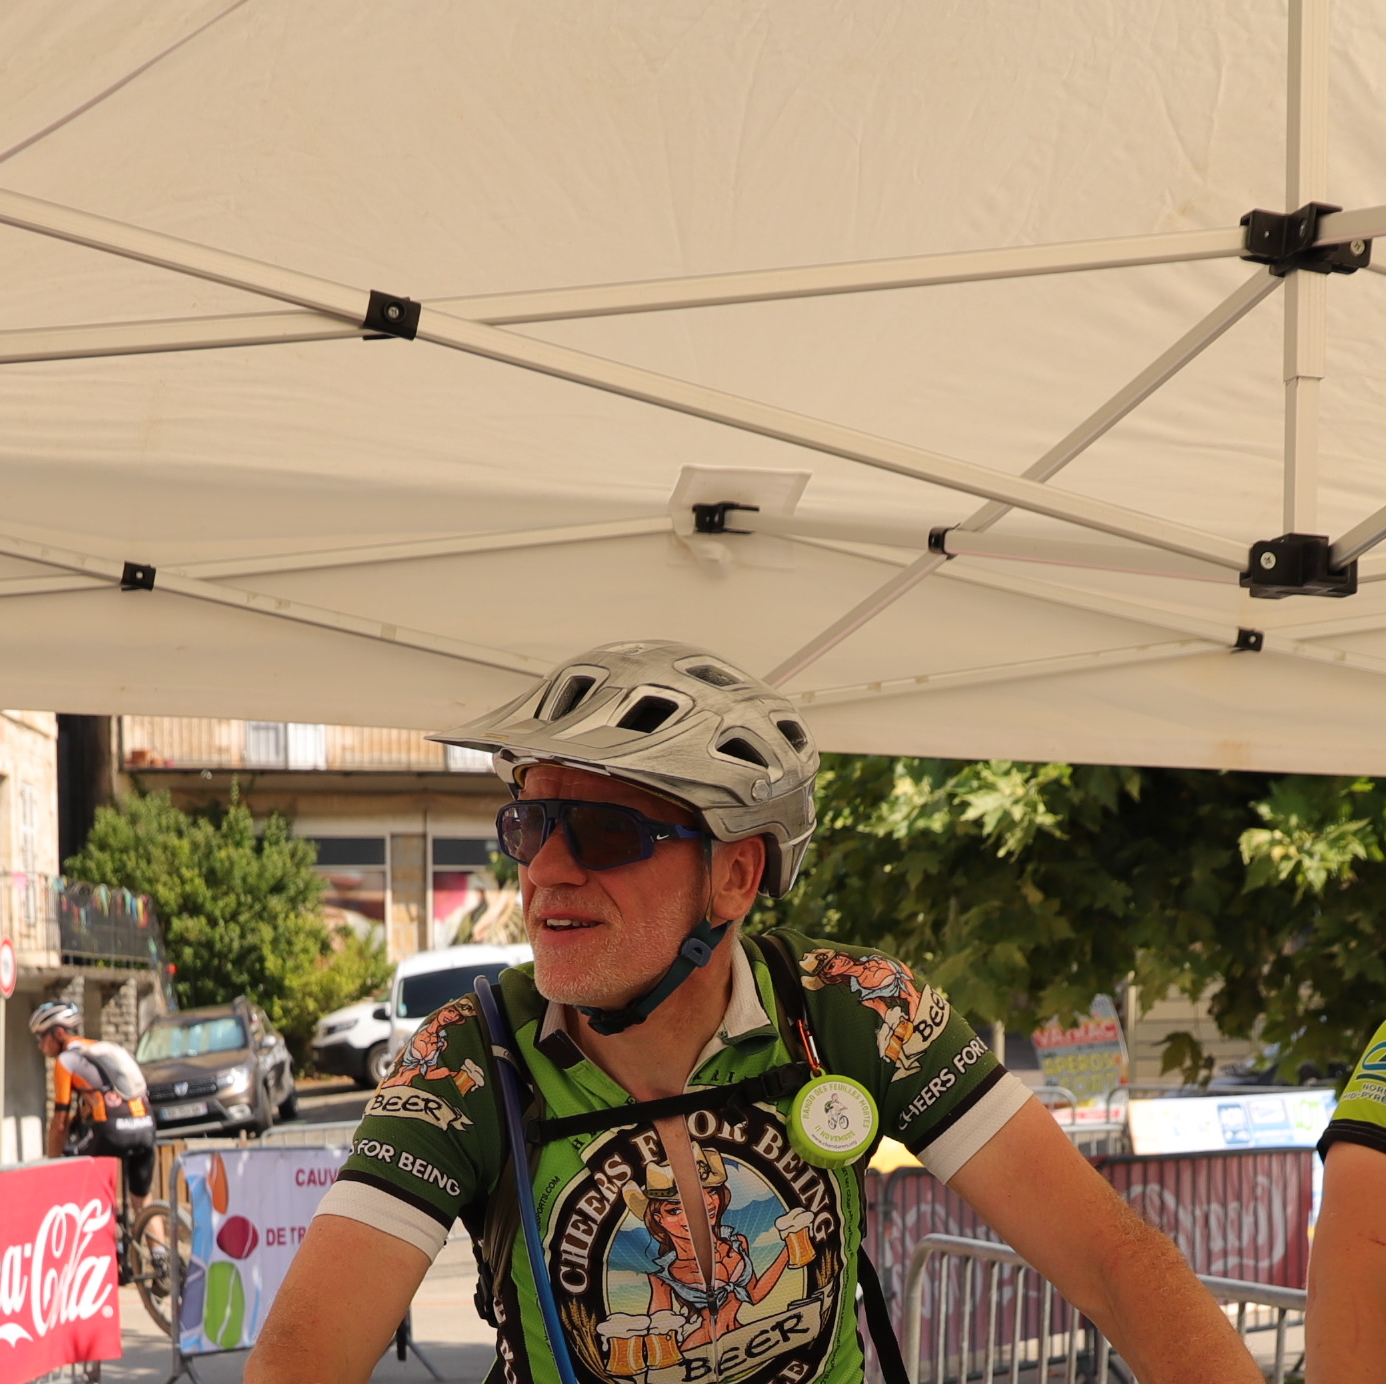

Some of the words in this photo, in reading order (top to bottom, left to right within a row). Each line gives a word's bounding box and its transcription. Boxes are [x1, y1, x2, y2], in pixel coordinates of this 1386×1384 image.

[370, 1094, 444, 1121] BEER
[803, 1094, 817, 1119] RANDO
[814, 1084, 829, 1096] DES
[828, 1083, 862, 1100] FEUILLES
[898, 1067, 957, 1131] CHEERS
[357, 1140, 396, 1163] FOR
[397, 1151, 462, 1197] BEING
[266, 1227, 288, 1246] DE
[560, 1154, 632, 1295] CHEERS
[753, 1124, 836, 1243] BEING
[680, 1311, 811, 1384] BEER
